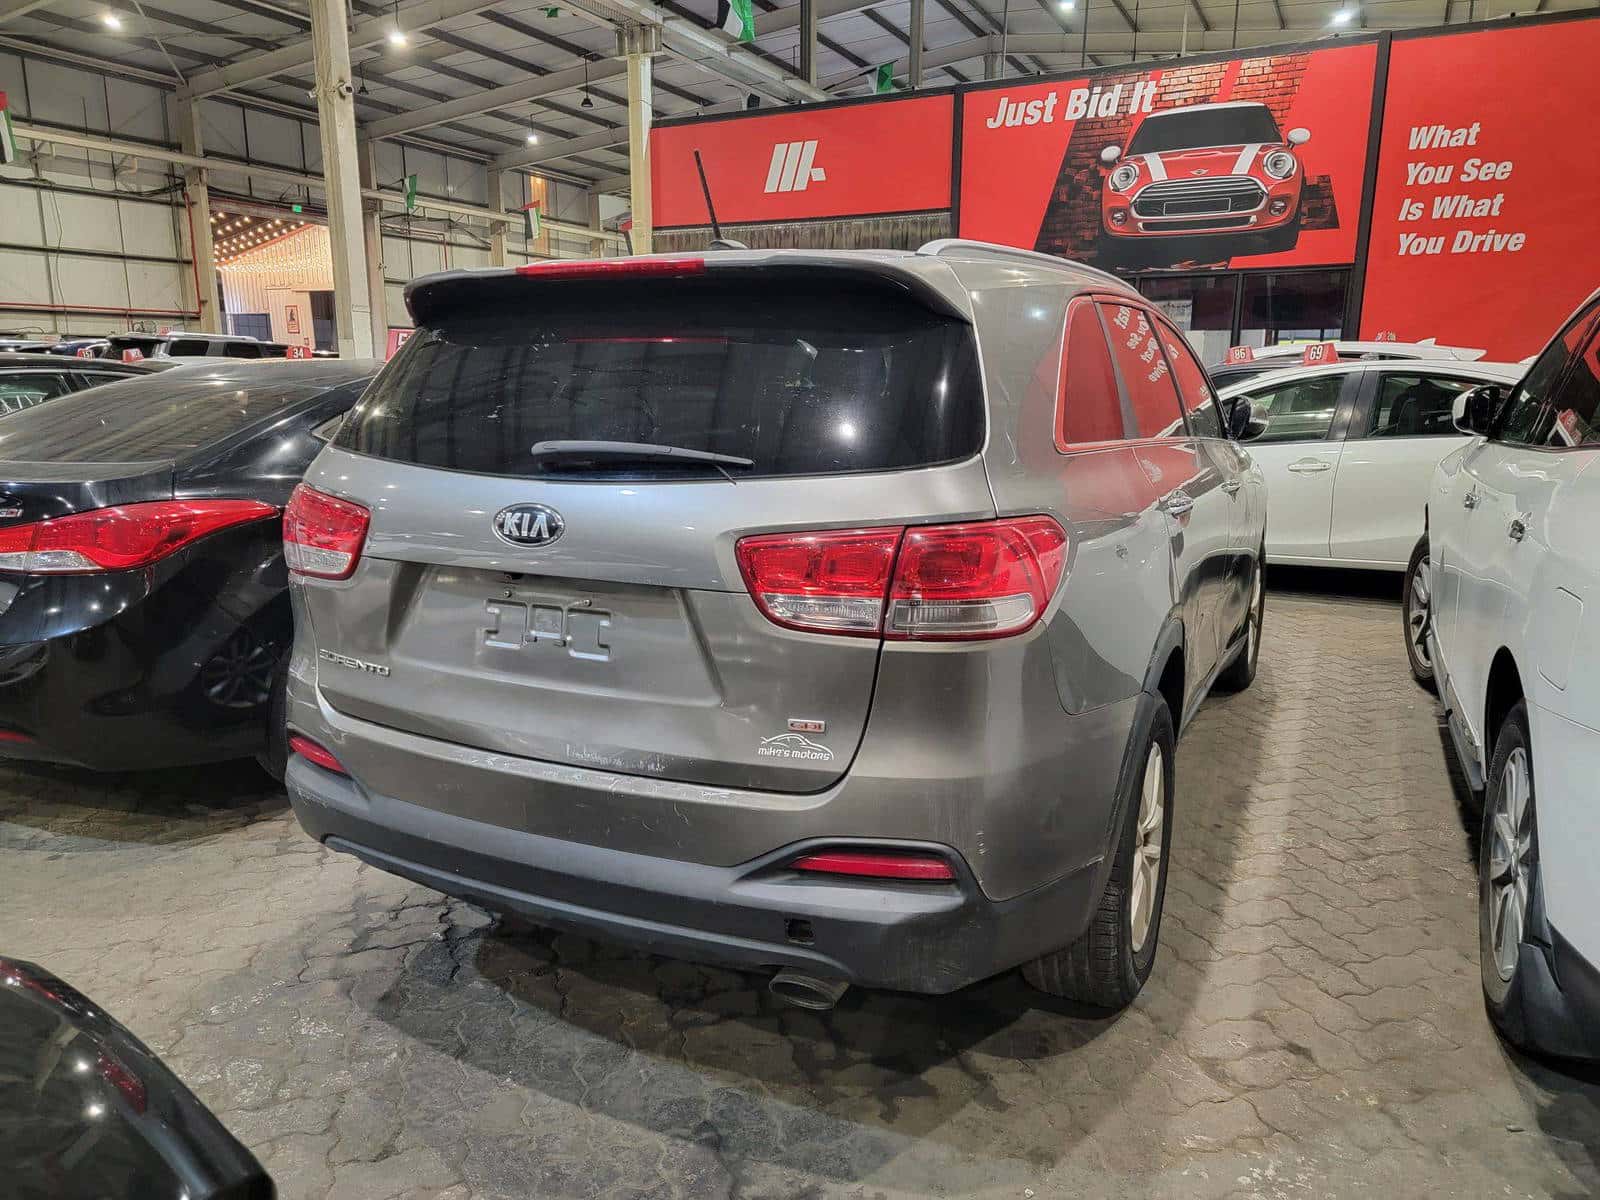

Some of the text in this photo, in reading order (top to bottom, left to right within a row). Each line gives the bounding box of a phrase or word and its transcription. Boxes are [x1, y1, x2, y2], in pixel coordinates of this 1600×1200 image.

[986, 80, 1158, 129] Just Bid It
[1408, 122, 1481, 150] What
[1406, 158, 1513, 186] You See
[1398, 193, 1505, 221] Is What
[1398, 229, 1526, 256] You Drive
[1310, 345, 1323, 360] 69
[503, 512, 550, 538] KIA
